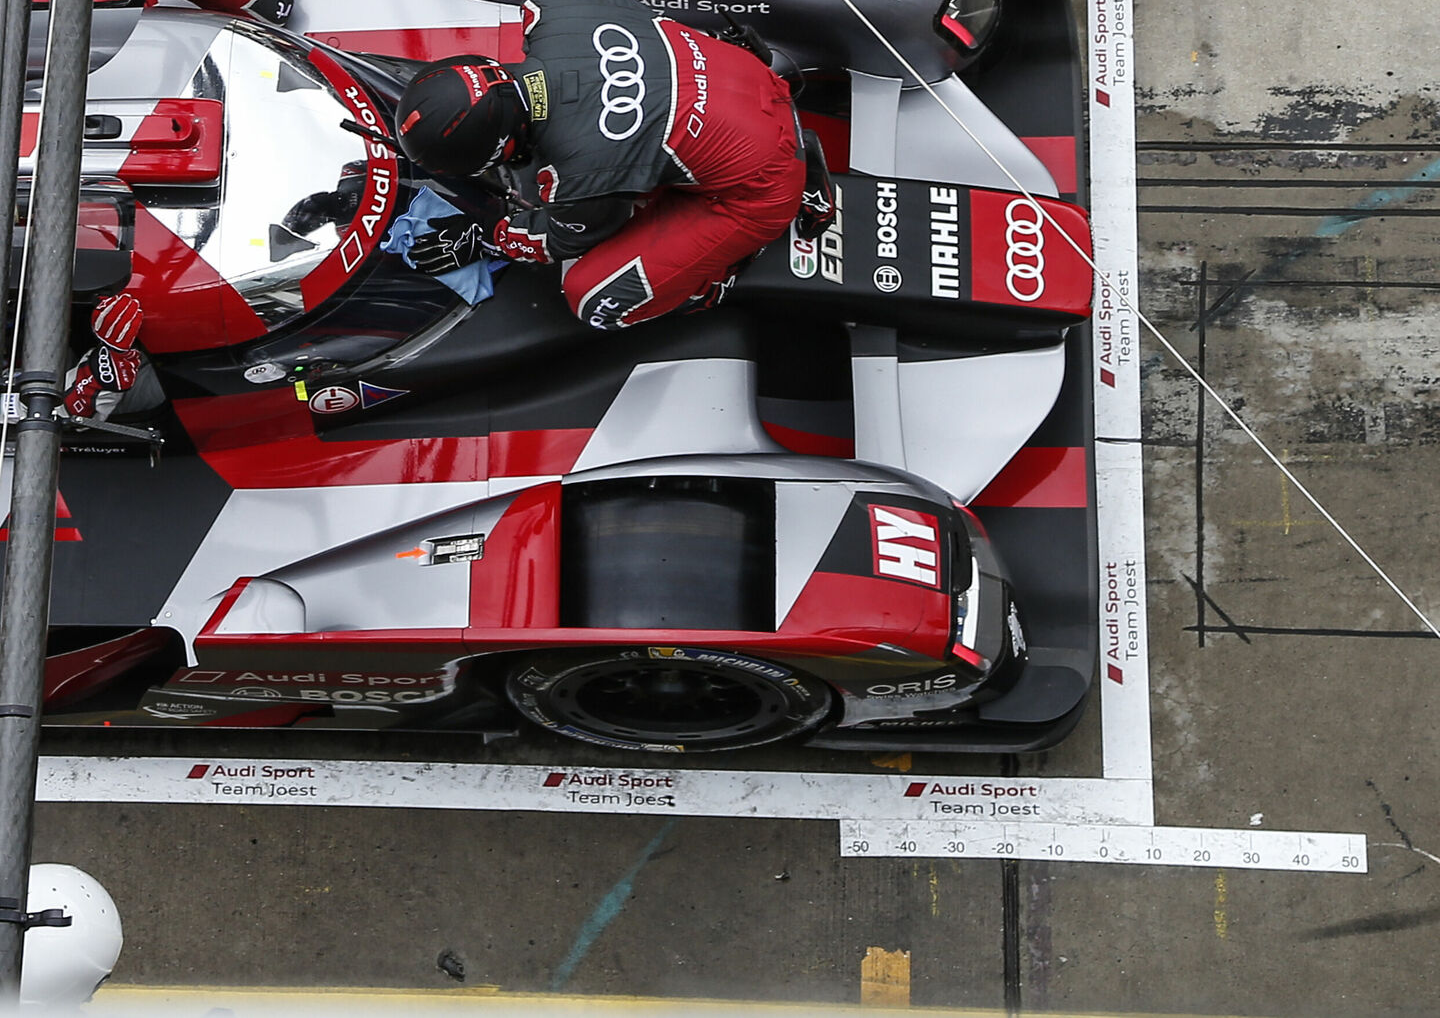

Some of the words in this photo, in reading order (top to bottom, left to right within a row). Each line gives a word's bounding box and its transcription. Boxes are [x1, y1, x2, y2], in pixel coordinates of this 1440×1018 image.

[680, 29, 707, 72] Sport
[1094, 49, 1108, 87] Audi
[1112, 42, 1126, 87] Team
[692, 73, 708, 115] Audi
[360, 167, 392, 238] Audi
[876, 182, 898, 259] BOSCH
[929, 186, 960, 299] MAHLE
[1116, 269, 1132, 314] Joest
[1098, 325, 1113, 366] Audi
[1117, 319, 1131, 367] Team
[873, 507, 937, 586] HY
[1105, 561, 1121, 614] Sport
[1124, 559, 1139, 607] Joest
[1105, 619, 1120, 661] Audi
[1125, 611, 1139, 661] Team
[235, 671, 326, 683] Audi
[695, 652, 788, 679] MICHELIN
[866, 674, 957, 695] ORIS
[168, 702, 204, 710] ACTION
[211, 765, 256, 778] Audi
[261, 765, 315, 780] Sport
[211, 782, 263, 795] Team
[268, 784, 318, 798] Joest
[568, 773, 613, 786] Audi
[618, 774, 674, 790] Sport
[929, 783, 976, 796] Audi
[980, 783, 1037, 799] Sport
[567, 790, 620, 804] Team
[625, 792, 676, 808] Joest
[929, 801, 984, 814] Team
[989, 802, 1041, 817] Joest
[846, 840, 870, 853] -50
[894, 840, 917, 853] -40
[942, 840, 965, 854] -30
[991, 842, 1014, 854] -20
[1040, 844, 1064, 857] -10
[1146, 848, 1162, 861] 10
[1193, 850, 1211, 862] 20
[1242, 851, 1261, 864] 30
[1292, 853, 1310, 866] 40
[1341, 855, 1359, 868] 50
